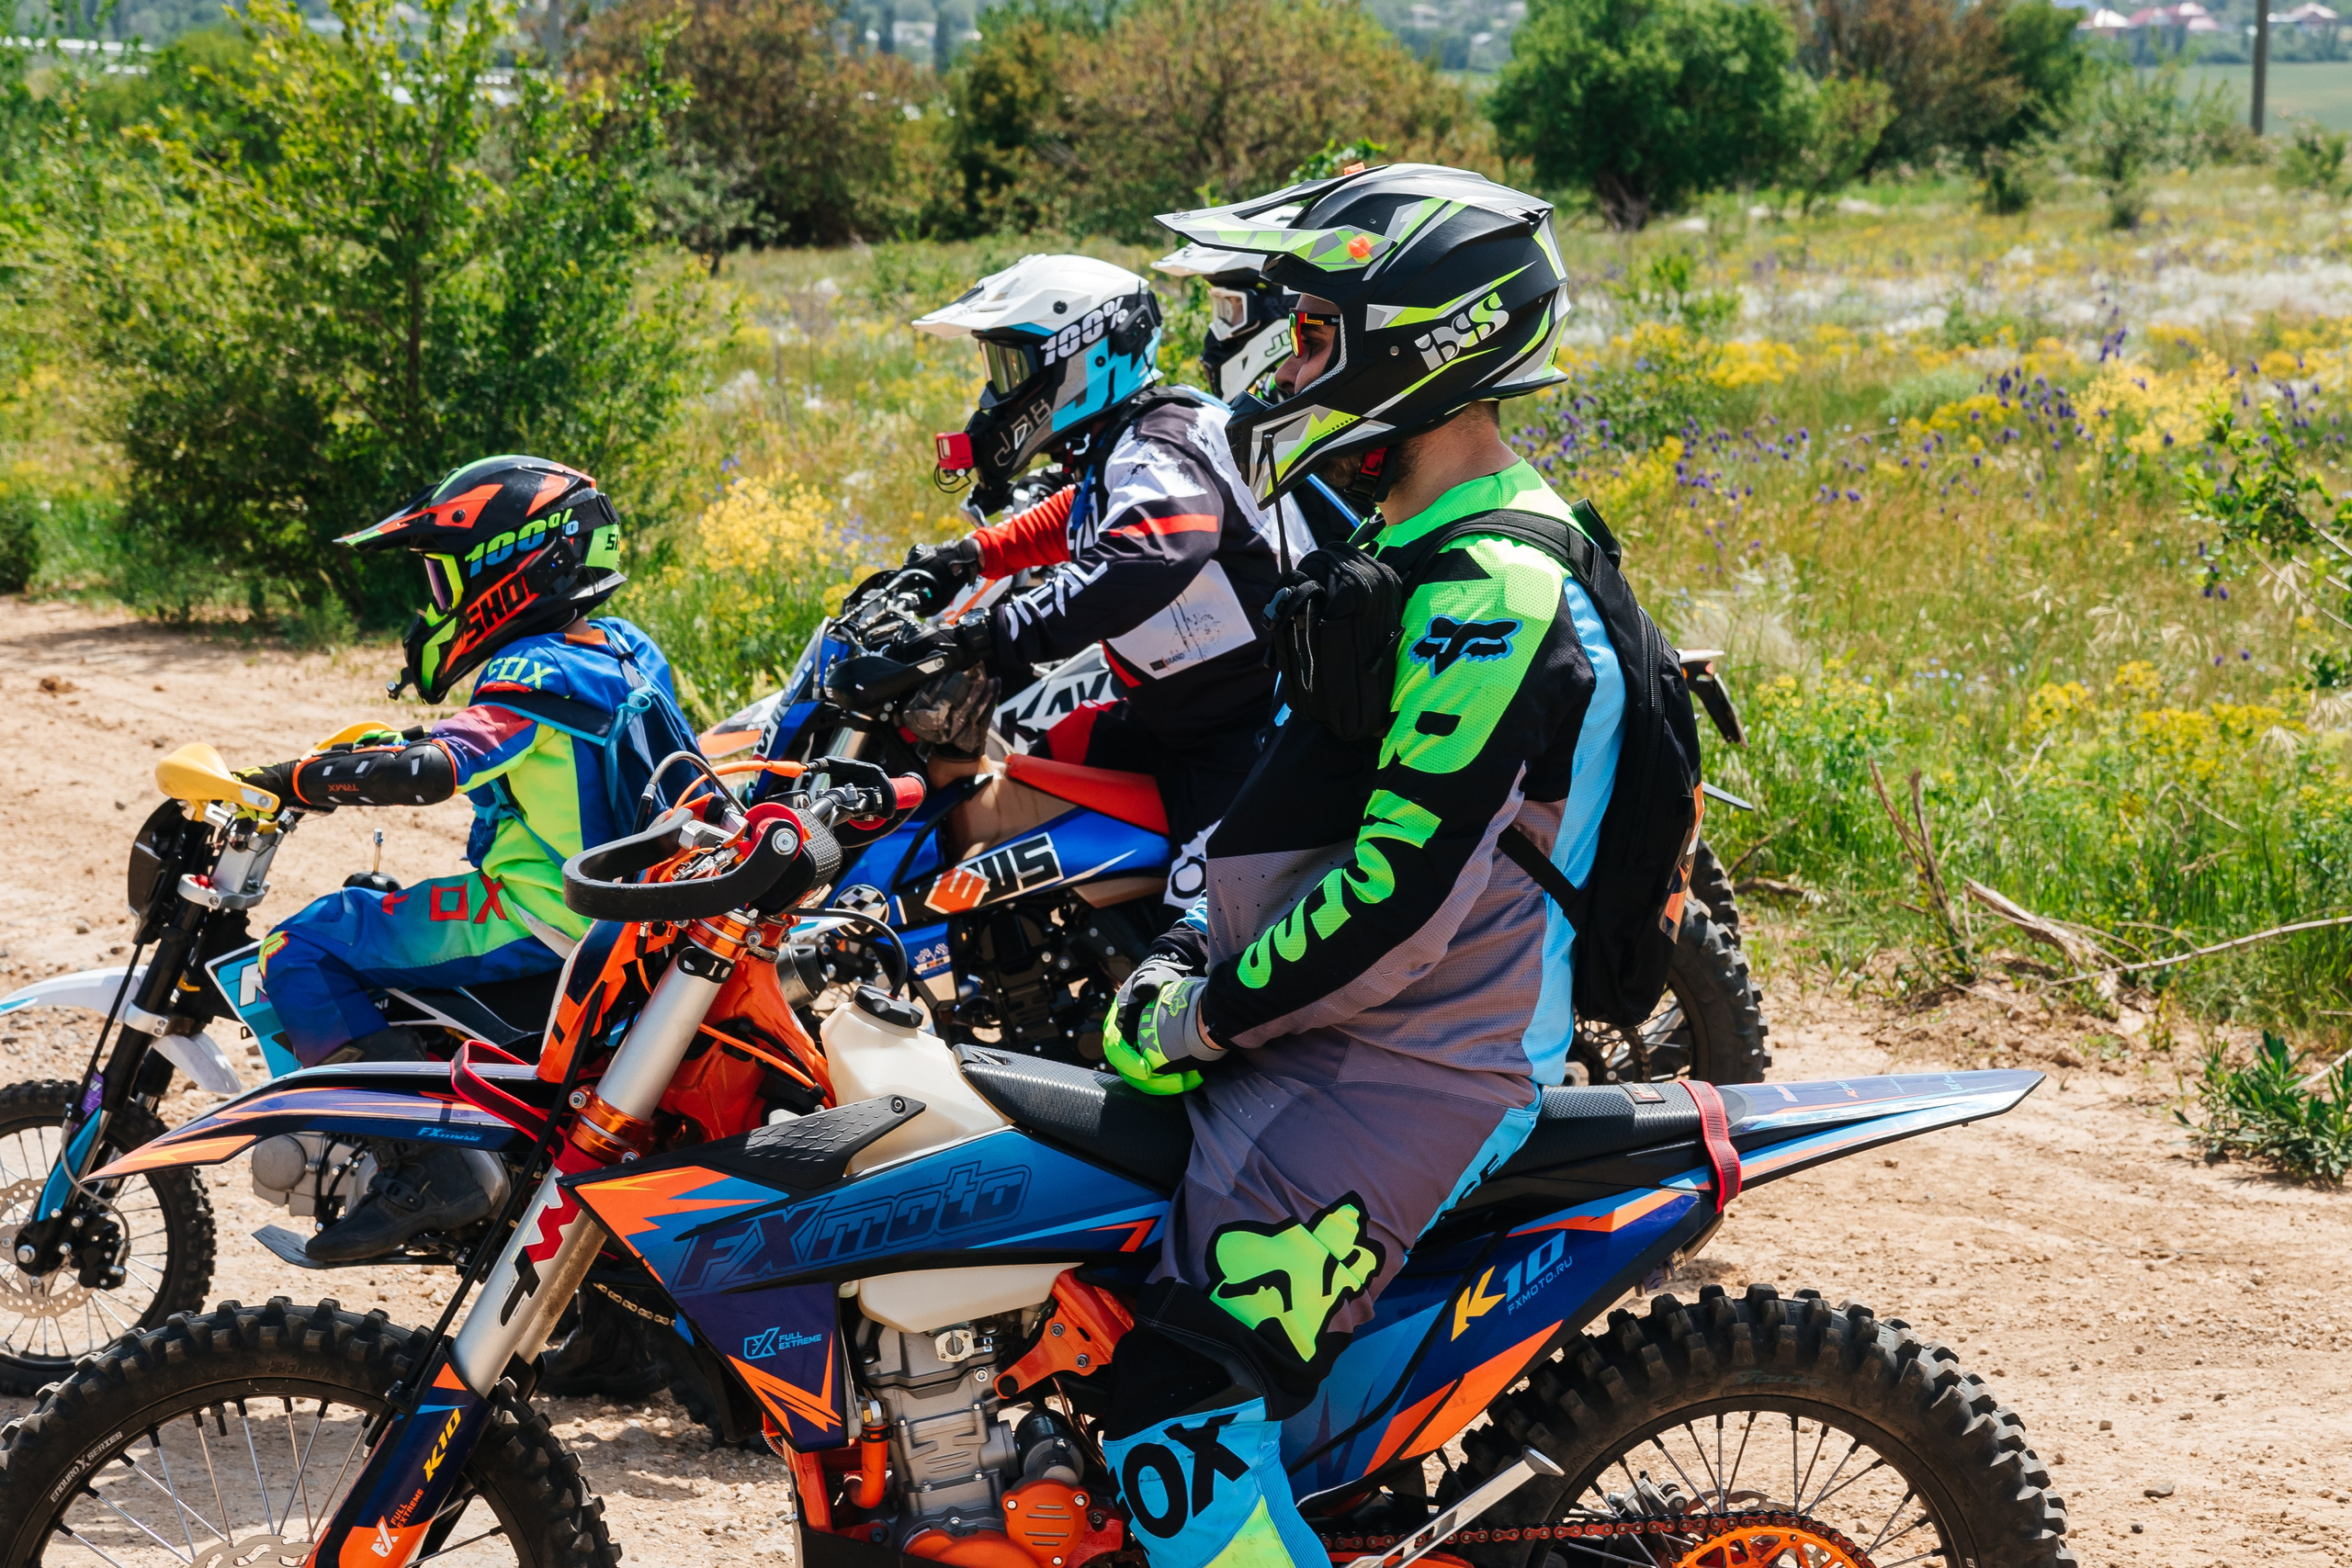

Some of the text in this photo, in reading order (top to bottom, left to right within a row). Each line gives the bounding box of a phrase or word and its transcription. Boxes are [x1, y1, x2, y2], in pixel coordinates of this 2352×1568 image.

[1040, 297, 1129, 367] 100%
[464, 508, 580, 579] 100%
[481, 656, 555, 690] FOX
[674, 1161, 1032, 1292] FXmoto
[1451, 1230, 1566, 1342] K10
[1507, 1256, 1573, 1314] FXMOTO.RU
[778, 1331, 803, 1342] FULL
[778, 1334, 822, 1349] EXTREME
[50, 1466, 80, 1503] ENDURO
[86, 1431, 123, 1461] SERIES
[424, 1407, 461, 1483] K10
[390, 1503, 408, 1526] FULL
[397, 1488, 424, 1529] EXTREME
